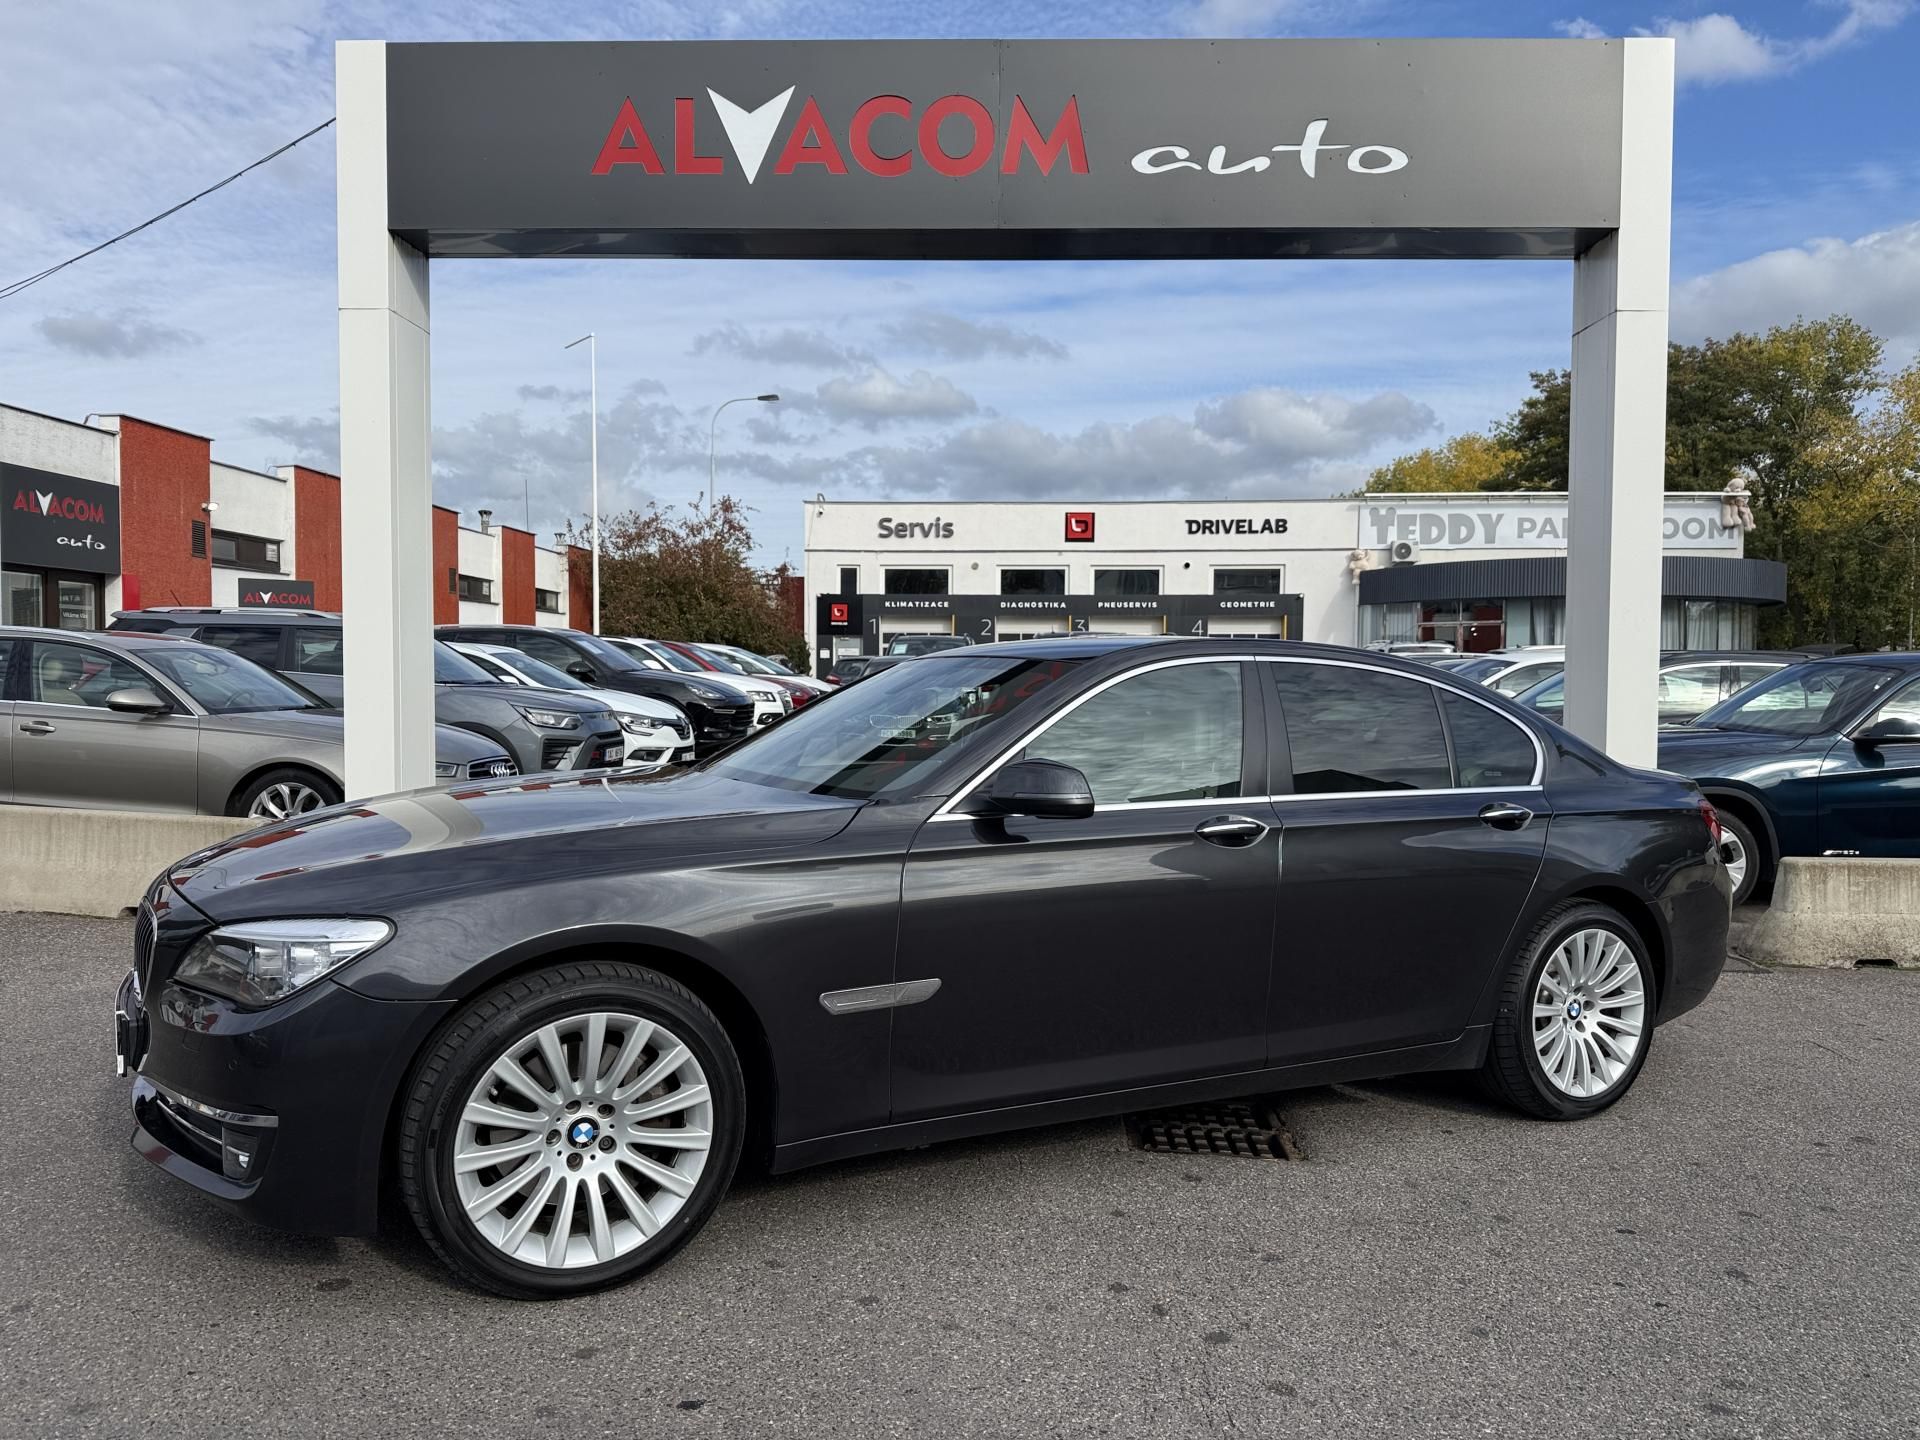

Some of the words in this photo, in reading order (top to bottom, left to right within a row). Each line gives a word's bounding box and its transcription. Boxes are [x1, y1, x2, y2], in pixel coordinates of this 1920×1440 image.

[591, 85, 1090, 184] ALVACOM
[1131, 117, 1409, 178] auto
[13, 489, 104, 523] ALVACOM
[878, 517, 954, 538] Servis
[1185, 518, 1288, 534] DRIVELAB
[1369, 507, 1504, 545] TEDDY
[1662, 517, 1734, 539] OOM
[57, 534, 105, 549] auto
[243, 591, 311, 605] ALVACOM
[869, 618, 876, 635] 1
[980, 619, 992, 636] 2
[1074, 619, 1086, 632] 3
[1191, 619, 1204, 636] 4
